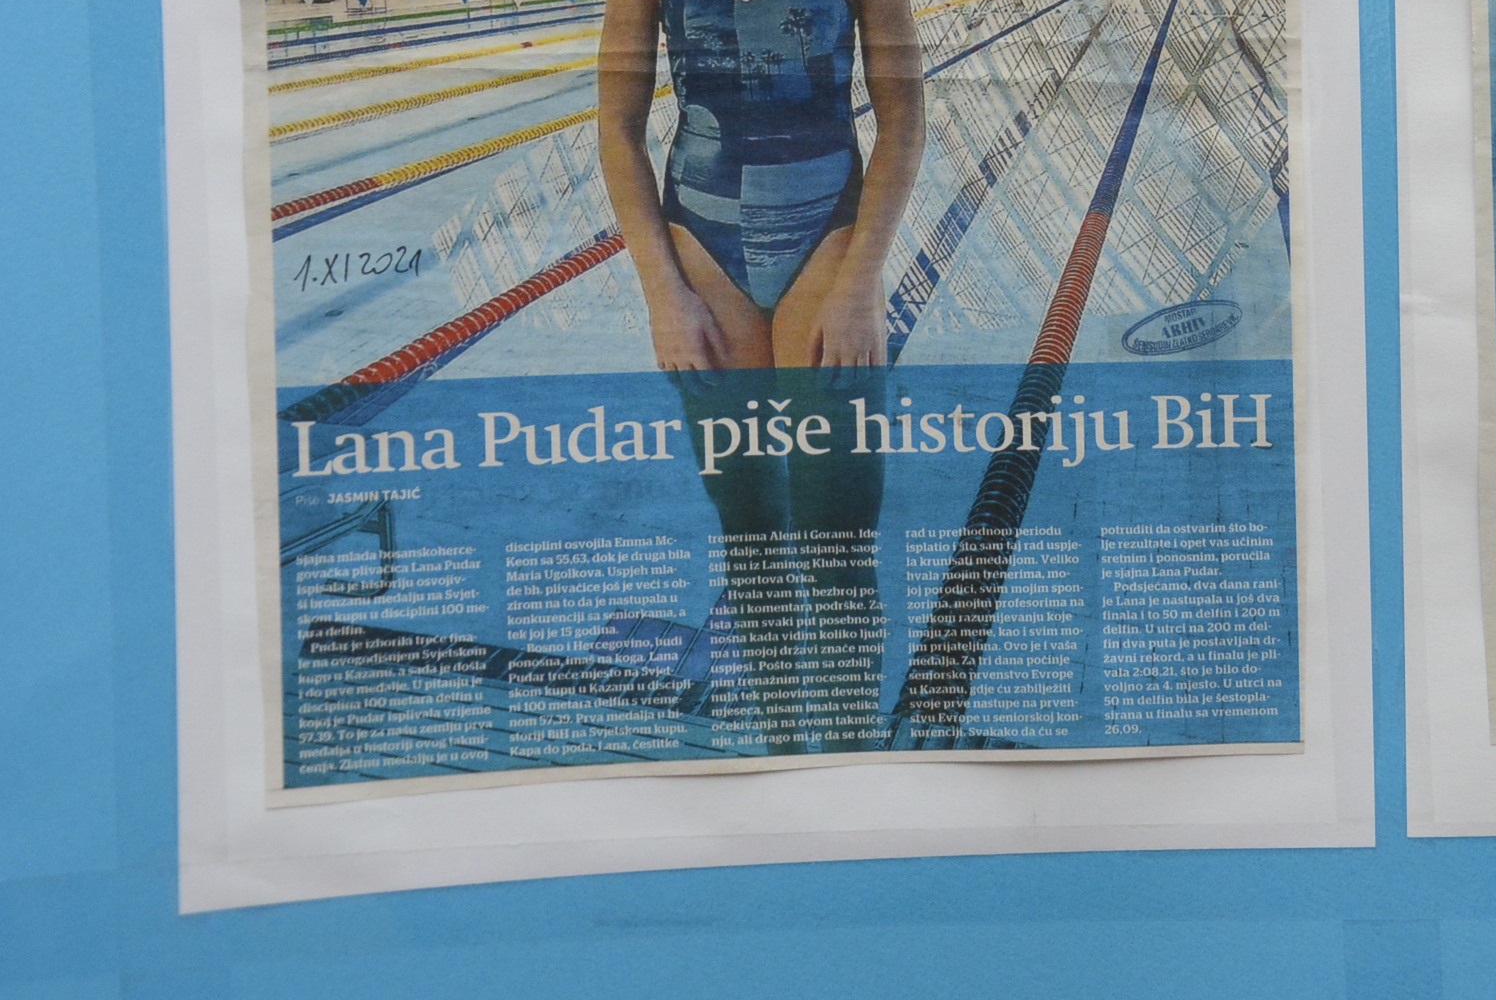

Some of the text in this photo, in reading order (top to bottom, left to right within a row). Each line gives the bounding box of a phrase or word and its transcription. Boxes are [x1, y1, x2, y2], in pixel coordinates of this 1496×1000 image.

[1163, 307, 1198, 323] MOSTAR
[1161, 316, 1207, 339] ARHIV
[290, 393, 1274, 478] Lana Pudar piše historiju BiH
[327, 490, 380, 505] JASMIN
[381, 487, 422, 502] TAJIĆ
[708, 527, 881, 543] trenerima Aleni i Goranu. Ide-
[505, 535, 678, 555] disciplini osvojila Emma Mc-
[296, 559, 481, 581] govačka plivačica Lana Pudar
[506, 564, 678, 582] Maria Ugolkova. Uspjeh mla-
[708, 556, 883, 573] štili su iz Laninog Kluba vode-
[1101, 565, 1223, 581] je sjajna Lana Pudar.
[906, 570, 940, 581] hvala
[942, 570, 980, 584] mojim
[1047, 571, 1070, 579] mo-
[1193, 579, 1216, 590] dva
[1219, 579, 1250, 590] dana
[1252, 578, 1282, 589] rani-
[906, 584, 922, 598] joj
[979, 583, 1008, 594] svim
[1011, 583, 1049, 596] mojim
[1051, 584, 1084, 596] spon-
[507, 593, 678, 611] zirom na to da je nastupala u
[1102, 592, 1280, 609] je Lana je nastupala u još dva
[334, 610, 367, 624] kupu
[370, 611, 378, 620] u
[380, 605, 439, 621] disciplini
[442, 604, 464, 615] 100
[467, 604, 489, 614] me-
[507, 612, 585, 628] konkurenciji
[587, 613, 600, 622] sa
[679, 609, 687, 618] a
[908, 611, 1072, 626] velikom razumijevanju koje
[507, 624, 618, 642] tek joj je 15 godina.
[711, 657, 874, 676] uspjesi. Pošto sam sa ozbilj-
[909, 668, 1074, 683] seniorsko prvenstvo Evrope
[711, 686, 879, 703] nula tek polovinom devetog
[909, 687, 917, 695] u
[970, 683, 994, 697] gdje
[997, 683, 1011, 694] ću
[1013, 682, 1071, 696] zabilježiti
[1104, 708, 1279, 721] sirana u finalu sa vremenom
